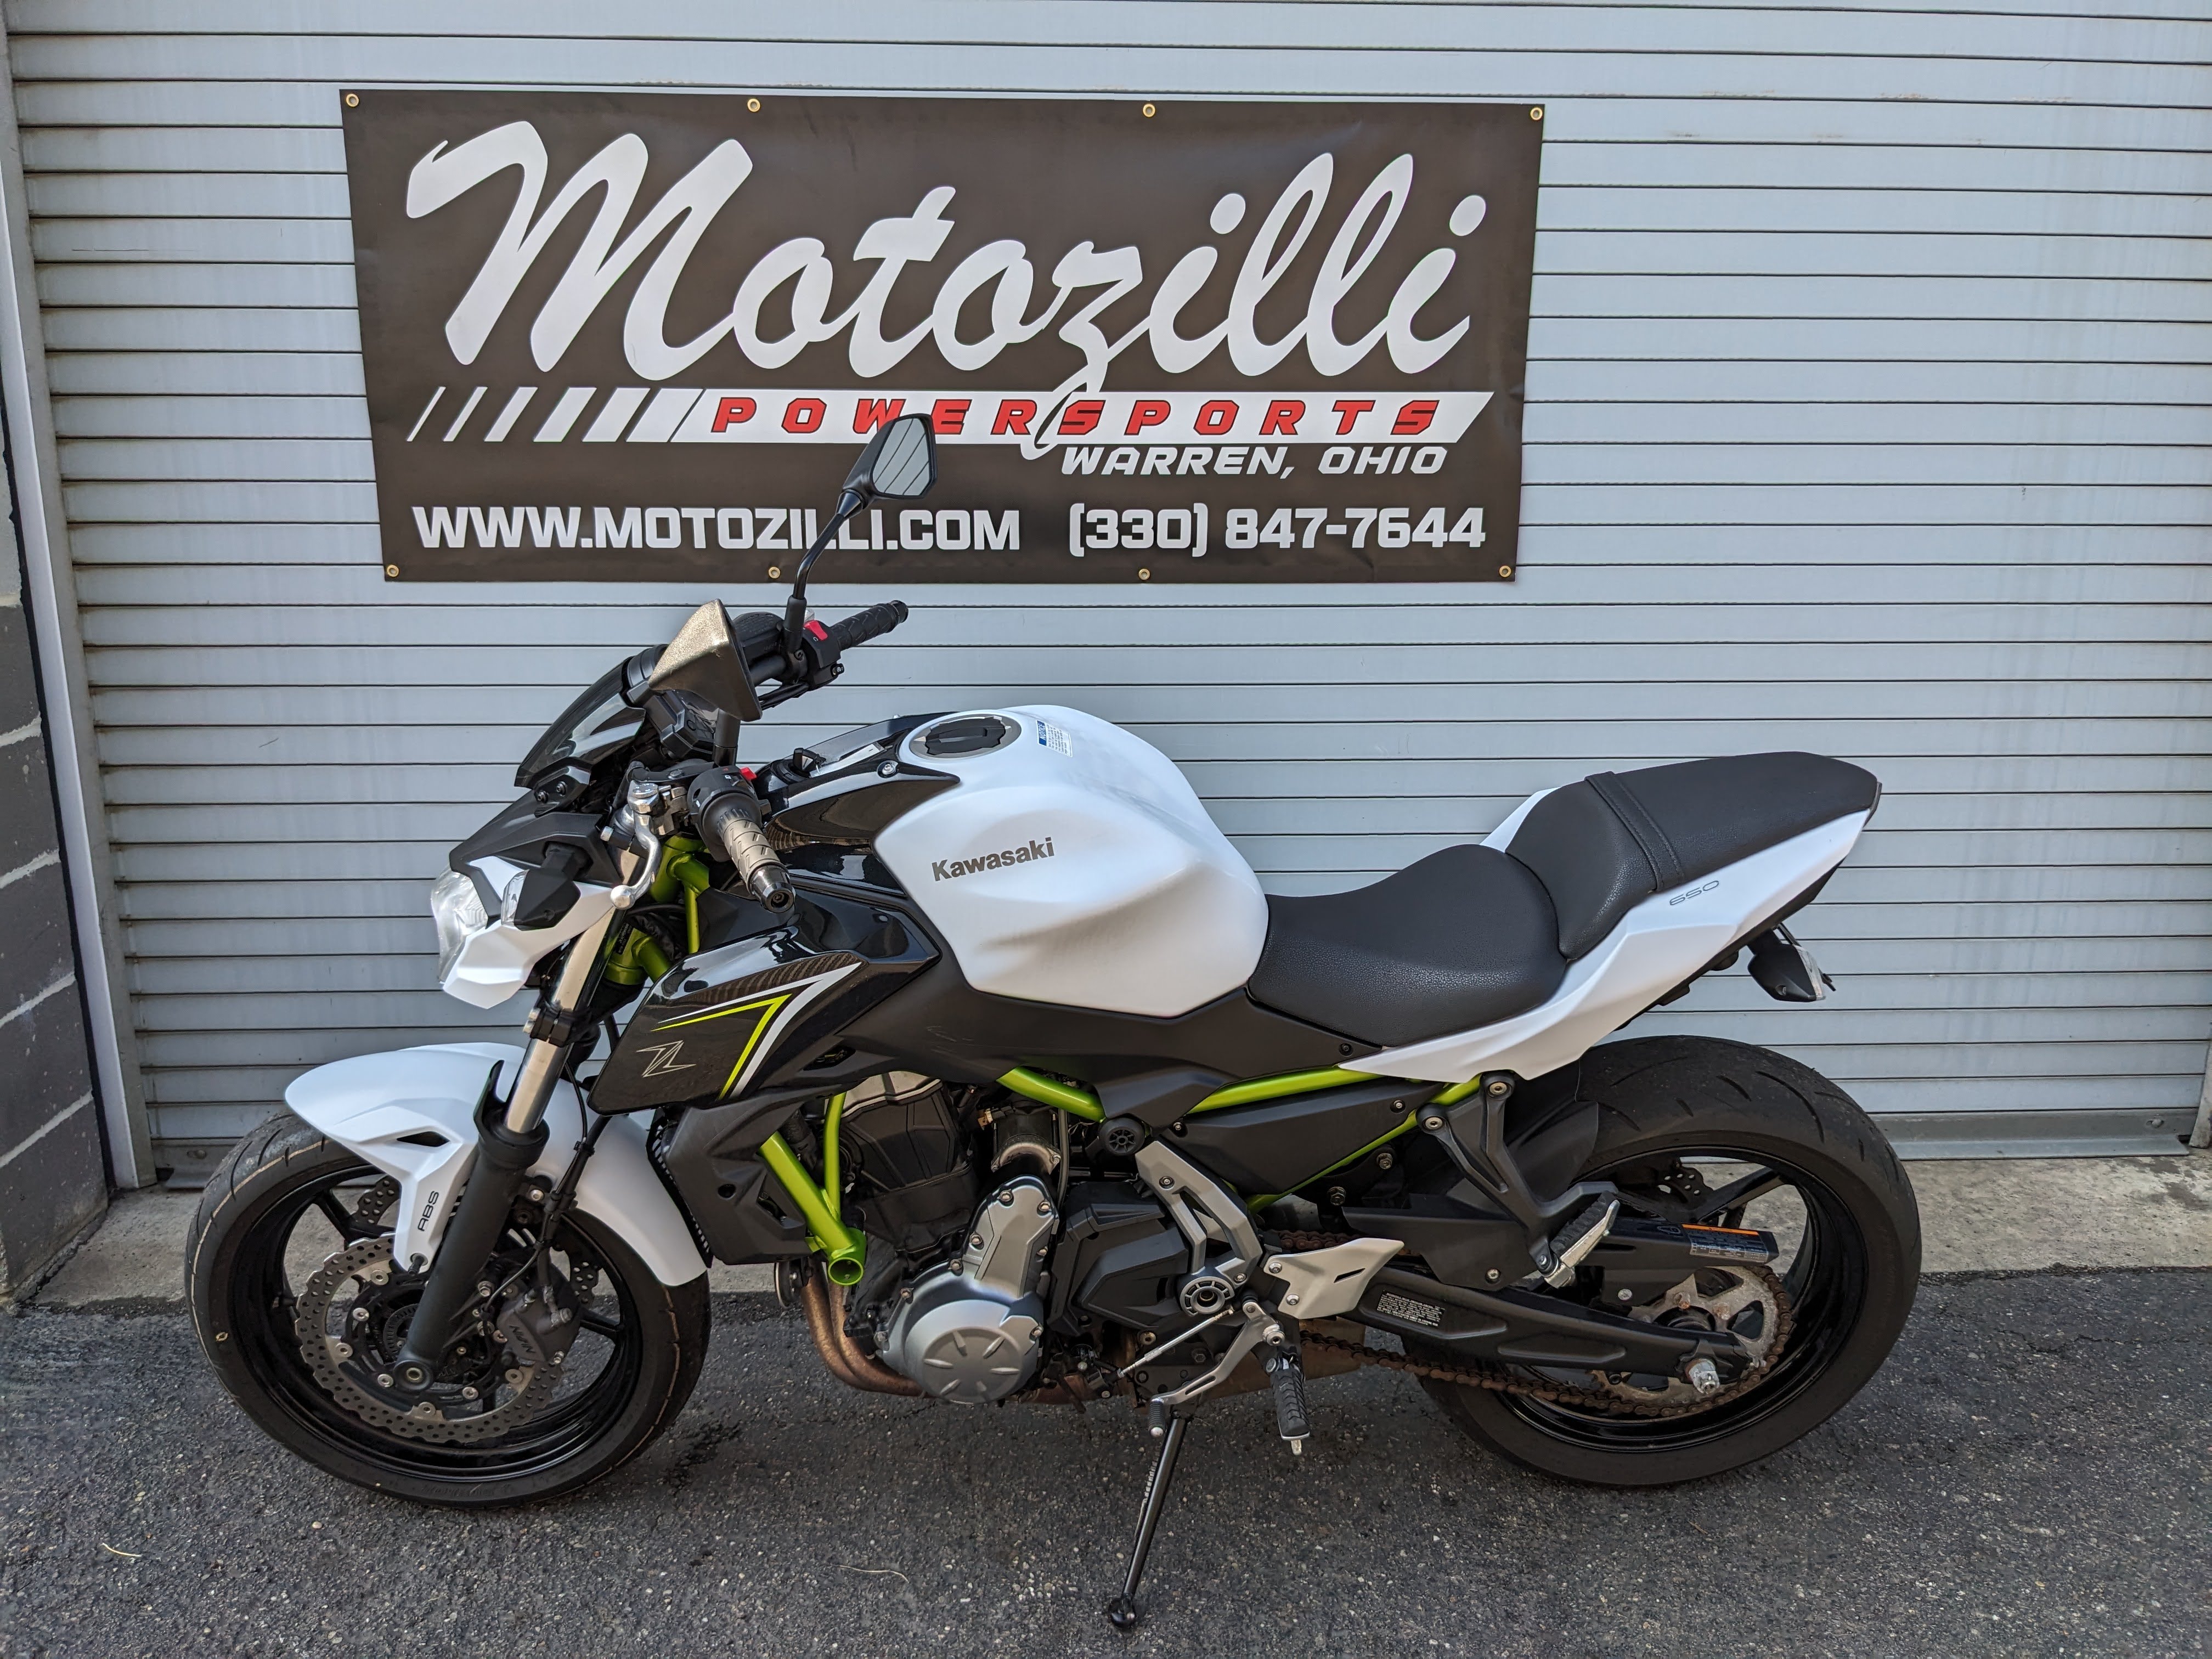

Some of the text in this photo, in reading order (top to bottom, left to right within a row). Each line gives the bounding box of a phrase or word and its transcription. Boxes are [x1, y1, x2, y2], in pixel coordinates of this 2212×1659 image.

[405, 121, 1486, 460] Motozilli
[711, 397, 1440, 436] POWERSPORTS
[1061, 446, 1448, 479] WARREN, OHIO
[411, 506, 1020, 550] WWW.MOTOZILLI.COM
[1225, 507, 1486, 550] 847-7644
[932, 837, 1055, 882] Kawasaki
[1669, 880, 1719, 906] 650
[417, 1190, 439, 1232] ABS
